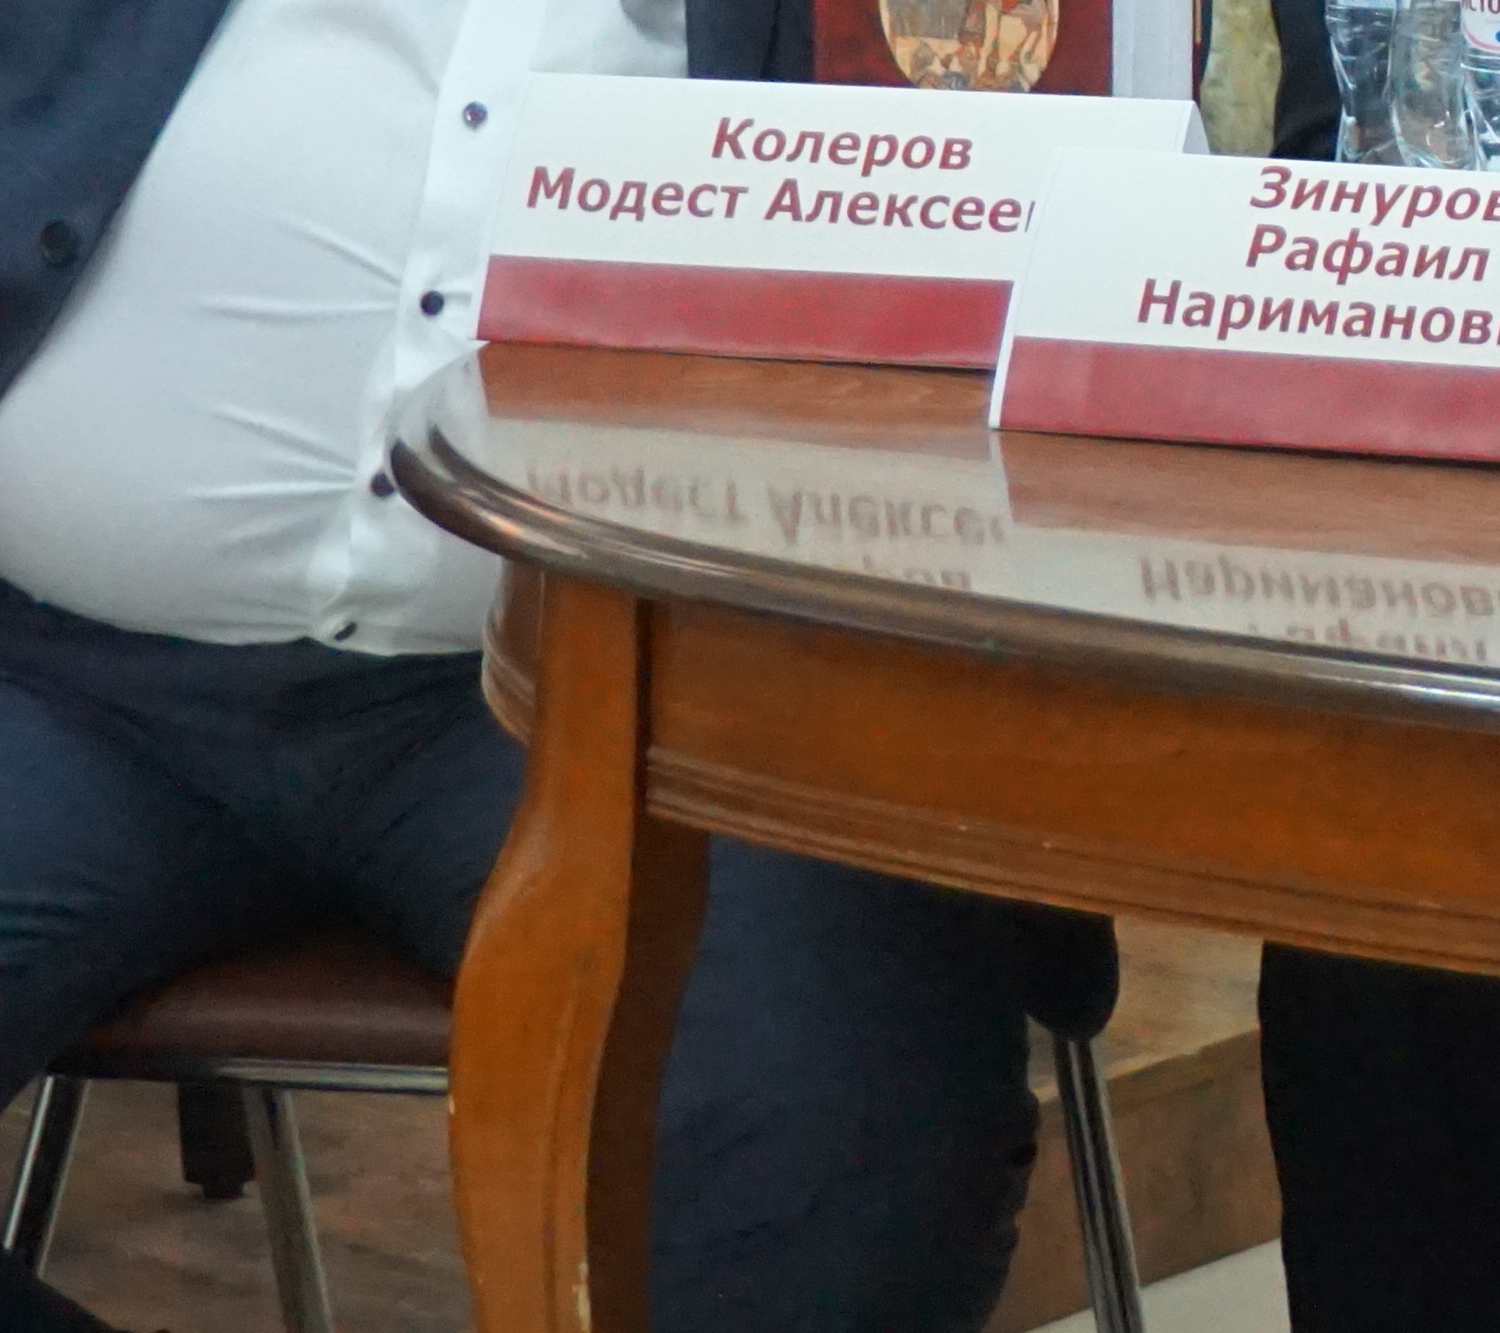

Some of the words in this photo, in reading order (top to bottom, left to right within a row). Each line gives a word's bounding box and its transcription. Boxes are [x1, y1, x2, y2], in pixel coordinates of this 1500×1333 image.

[711, 118, 973, 171] Колеров
[527, 167, 748, 223] Модест
[1246, 224, 1490, 285] Рафаил
